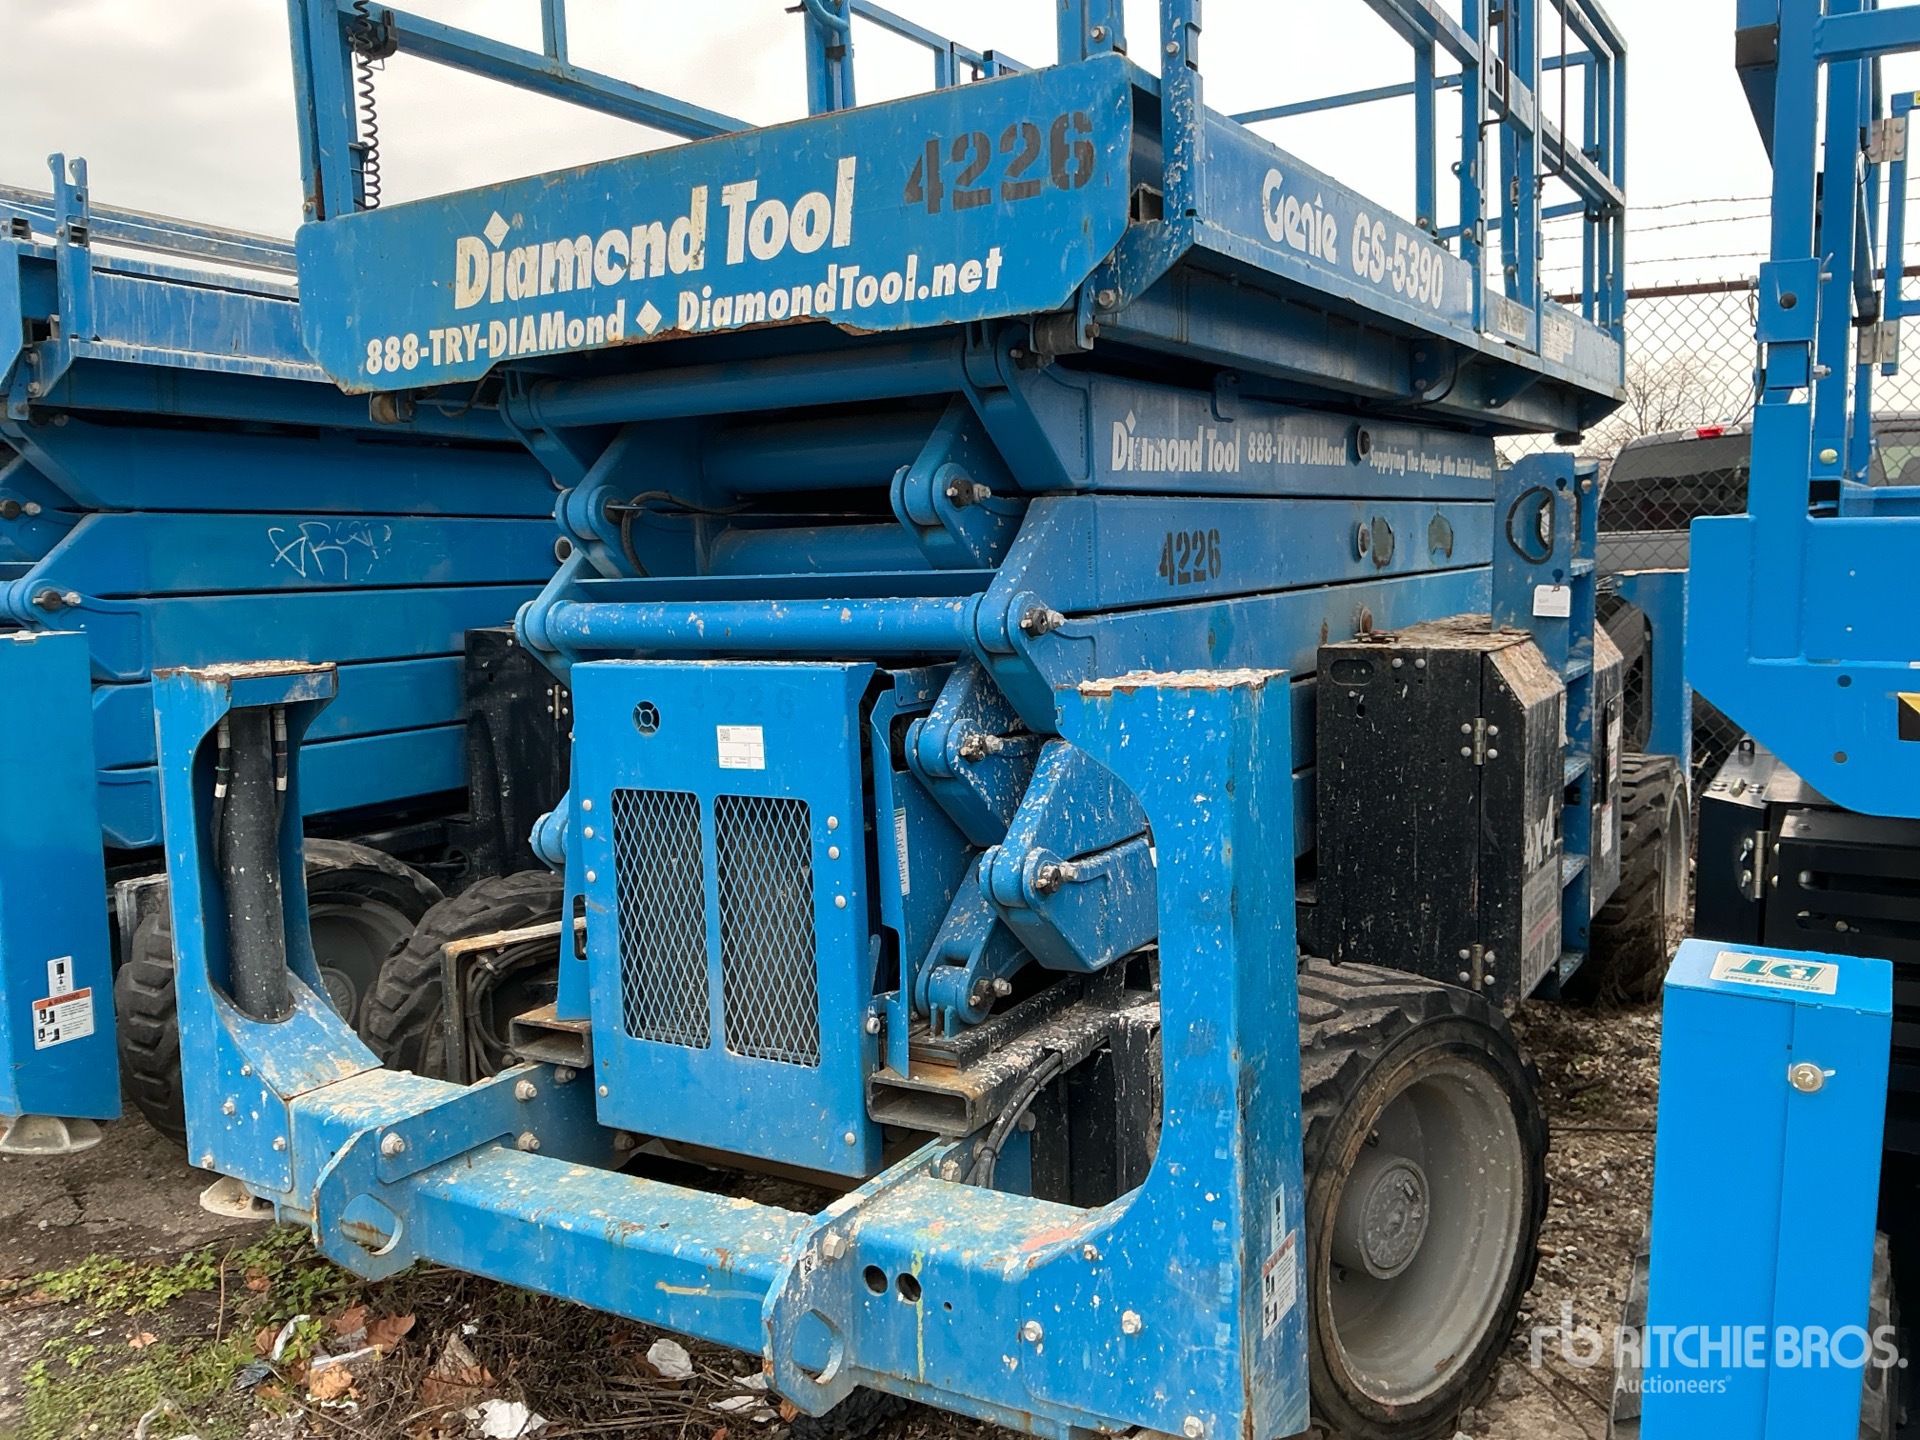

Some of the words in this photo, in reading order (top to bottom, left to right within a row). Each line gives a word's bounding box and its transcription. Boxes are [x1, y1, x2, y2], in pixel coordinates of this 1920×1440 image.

[905, 111, 1094, 214] 4226
[455, 185, 708, 310] Diamond
[722, 156, 857, 265] Tool
[1262, 168, 1338, 265] Genie
[1352, 211, 1444, 310] GS-5390
[366, 299, 625, 375] 888-TRY-DIAMond
[678, 247, 1003, 331] DiamondTool.net
[1112, 409, 1204, 472] Diamond
[1207, 428, 1240, 473] Tool
[1248, 431, 1347, 467] 888-TRY-DIAMond
[1370, 444, 1405, 477] Supplying
[1407, 450, 1419, 472] The
[1420, 452, 1441, 479] People
[1159, 528, 1221, 585] 4226
